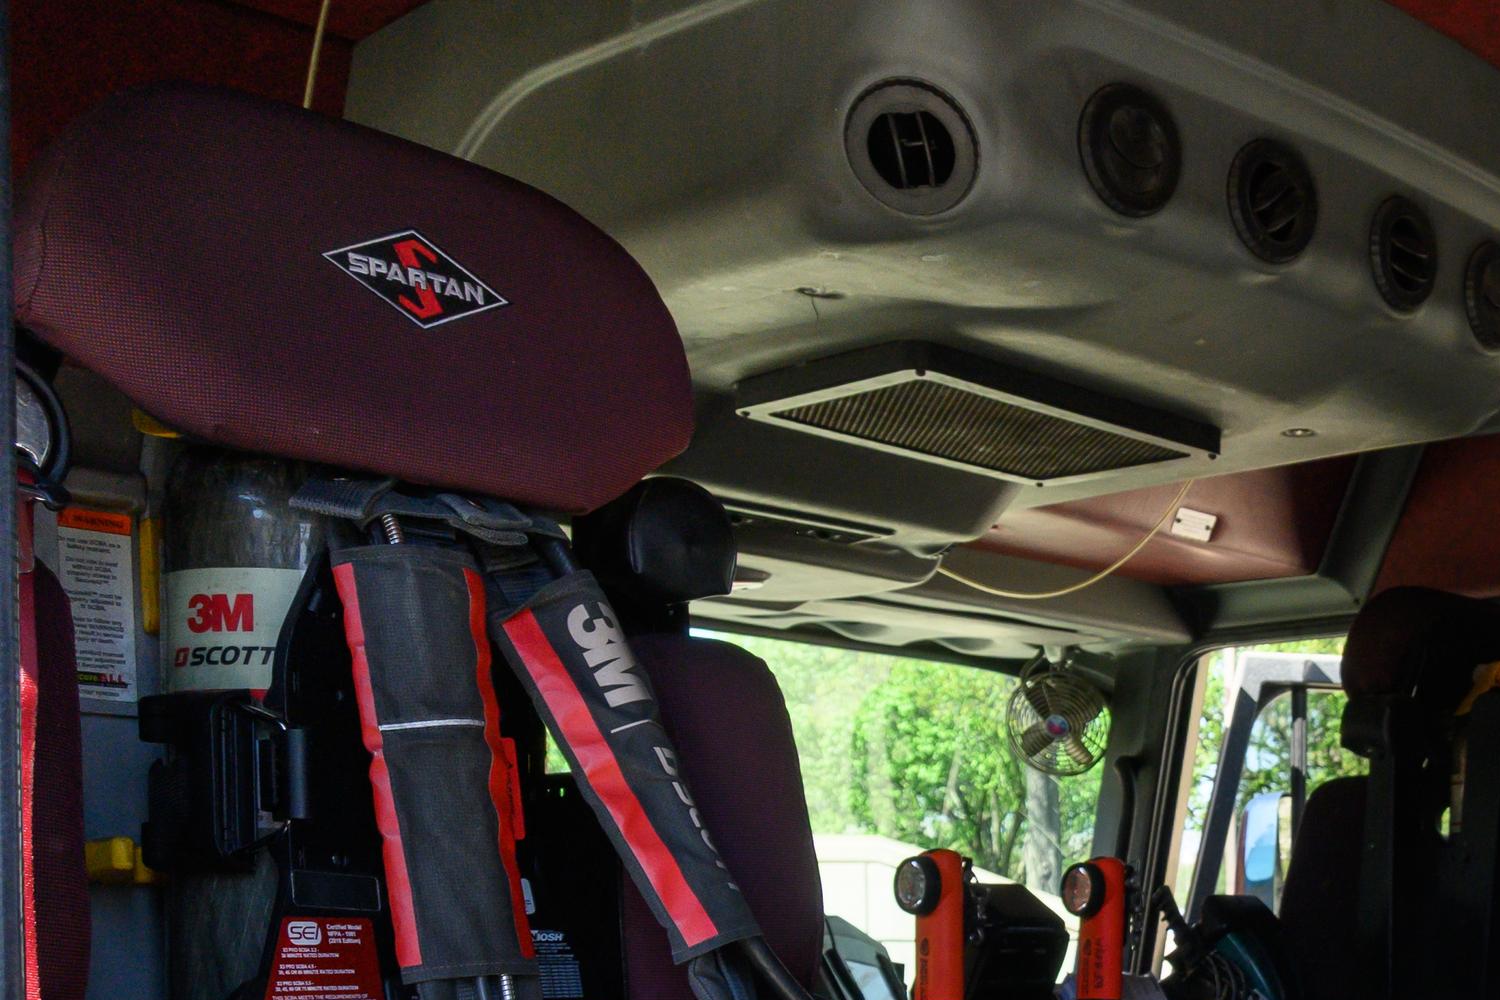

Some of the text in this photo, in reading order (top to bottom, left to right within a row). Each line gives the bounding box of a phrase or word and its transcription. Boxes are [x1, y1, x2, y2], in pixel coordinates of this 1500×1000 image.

[347, 251, 486, 306] SPARTAN
[187, 593, 254, 634] 3M
[190, 646, 276, 667] SCOTT
[567, 601, 653, 708] 3M
[289, 926, 319, 940] SEI
